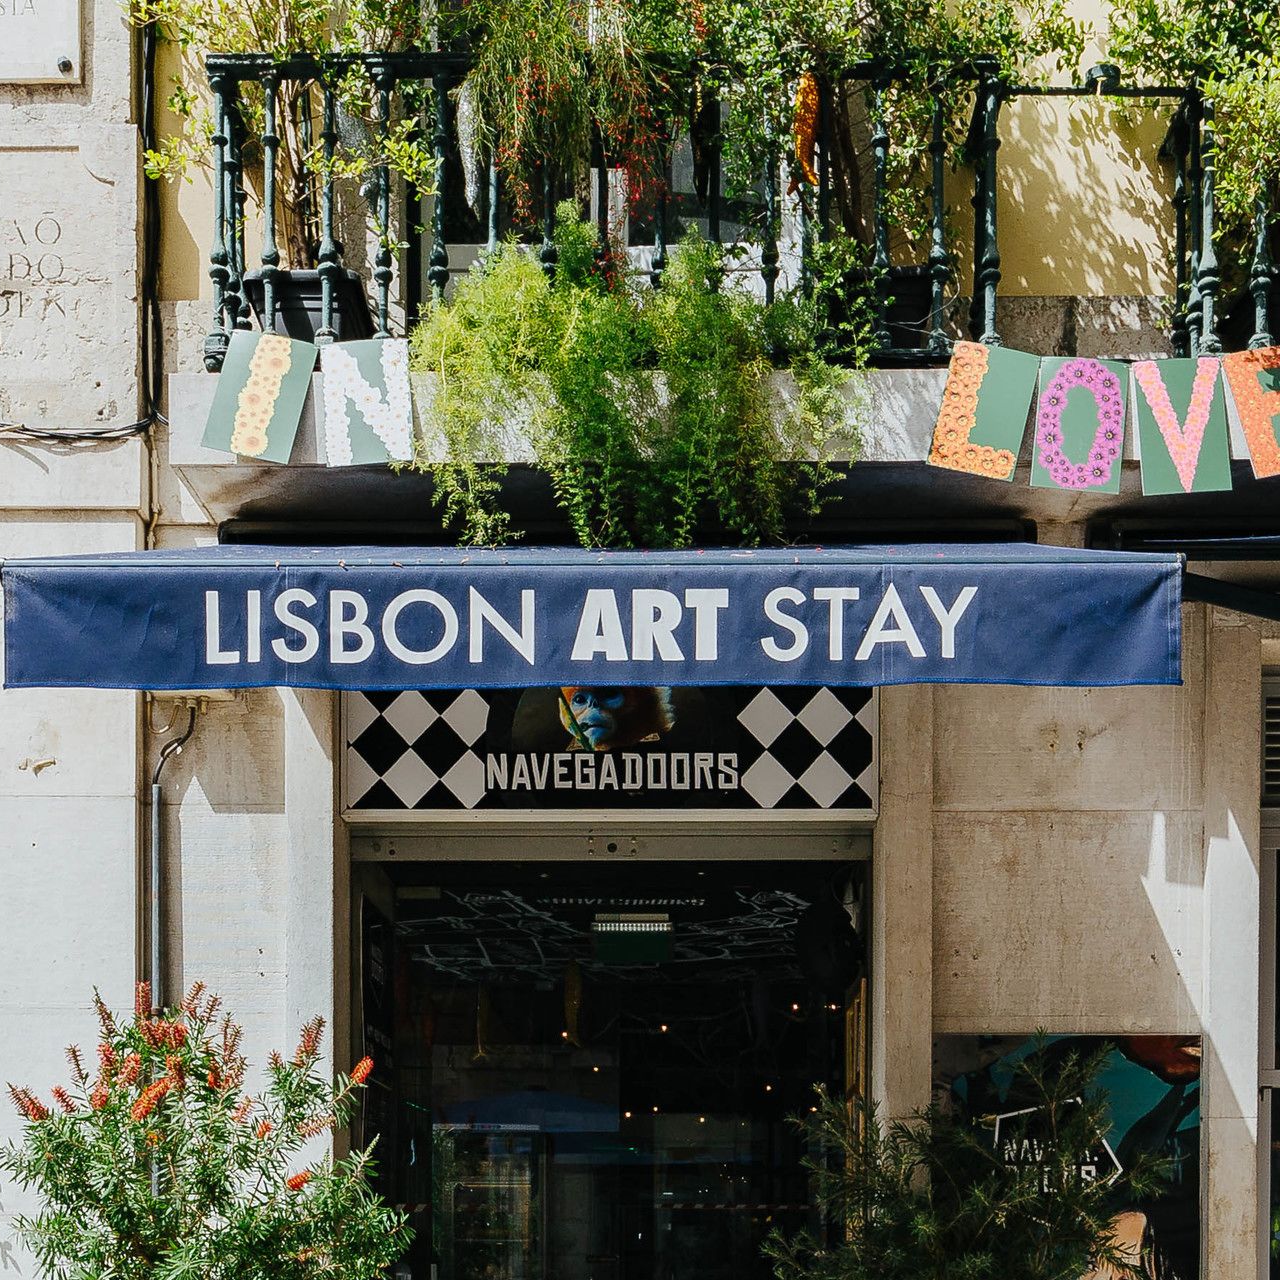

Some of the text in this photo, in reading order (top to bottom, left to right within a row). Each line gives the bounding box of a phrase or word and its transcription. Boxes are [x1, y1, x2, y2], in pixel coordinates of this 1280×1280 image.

[231, 335, 413, 467] IN
[205, 583, 979, 667] LISBON ART STAY
[486, 751, 740, 792] NAVEGADOORS
